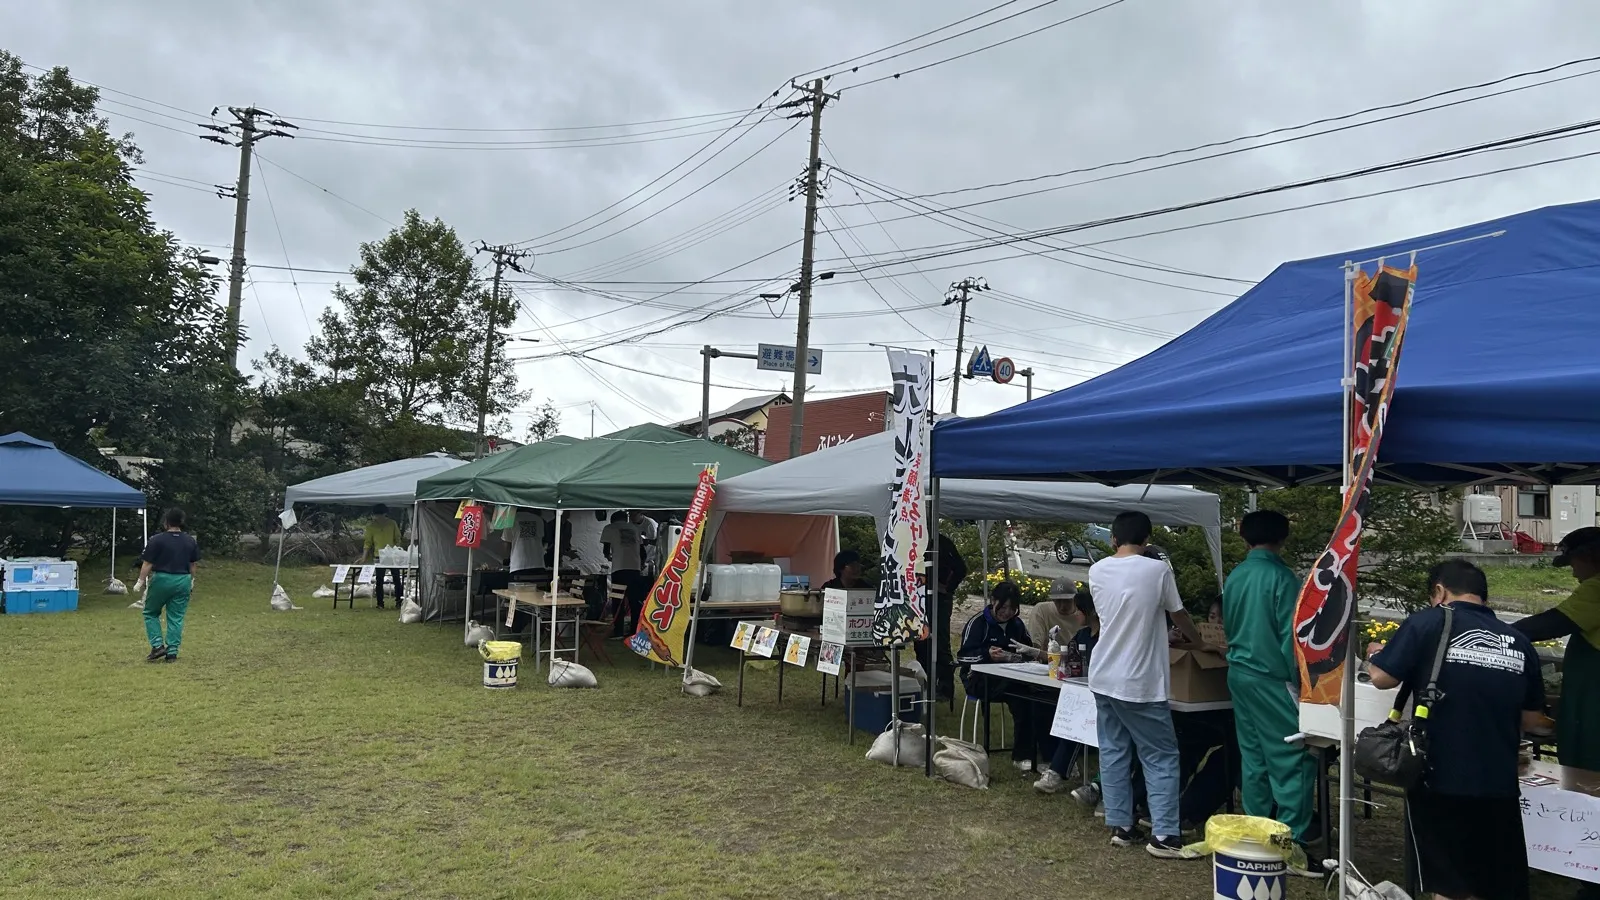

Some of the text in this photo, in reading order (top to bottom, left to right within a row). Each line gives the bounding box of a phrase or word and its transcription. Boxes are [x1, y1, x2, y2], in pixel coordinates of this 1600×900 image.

[762, 348, 795, 361] 避難場
[1000, 364, 1011, 377] 40
[462, 511, 476, 545] やきとり
[849, 618, 873, 629] ホクリ
[1500, 634, 1516, 645] TOP
[1447, 652, 1489, 662] YAKEHASHIRI
[1581, 827, 1600, 841] 30
[1236, 860, 1282, 871] DAPHNE
